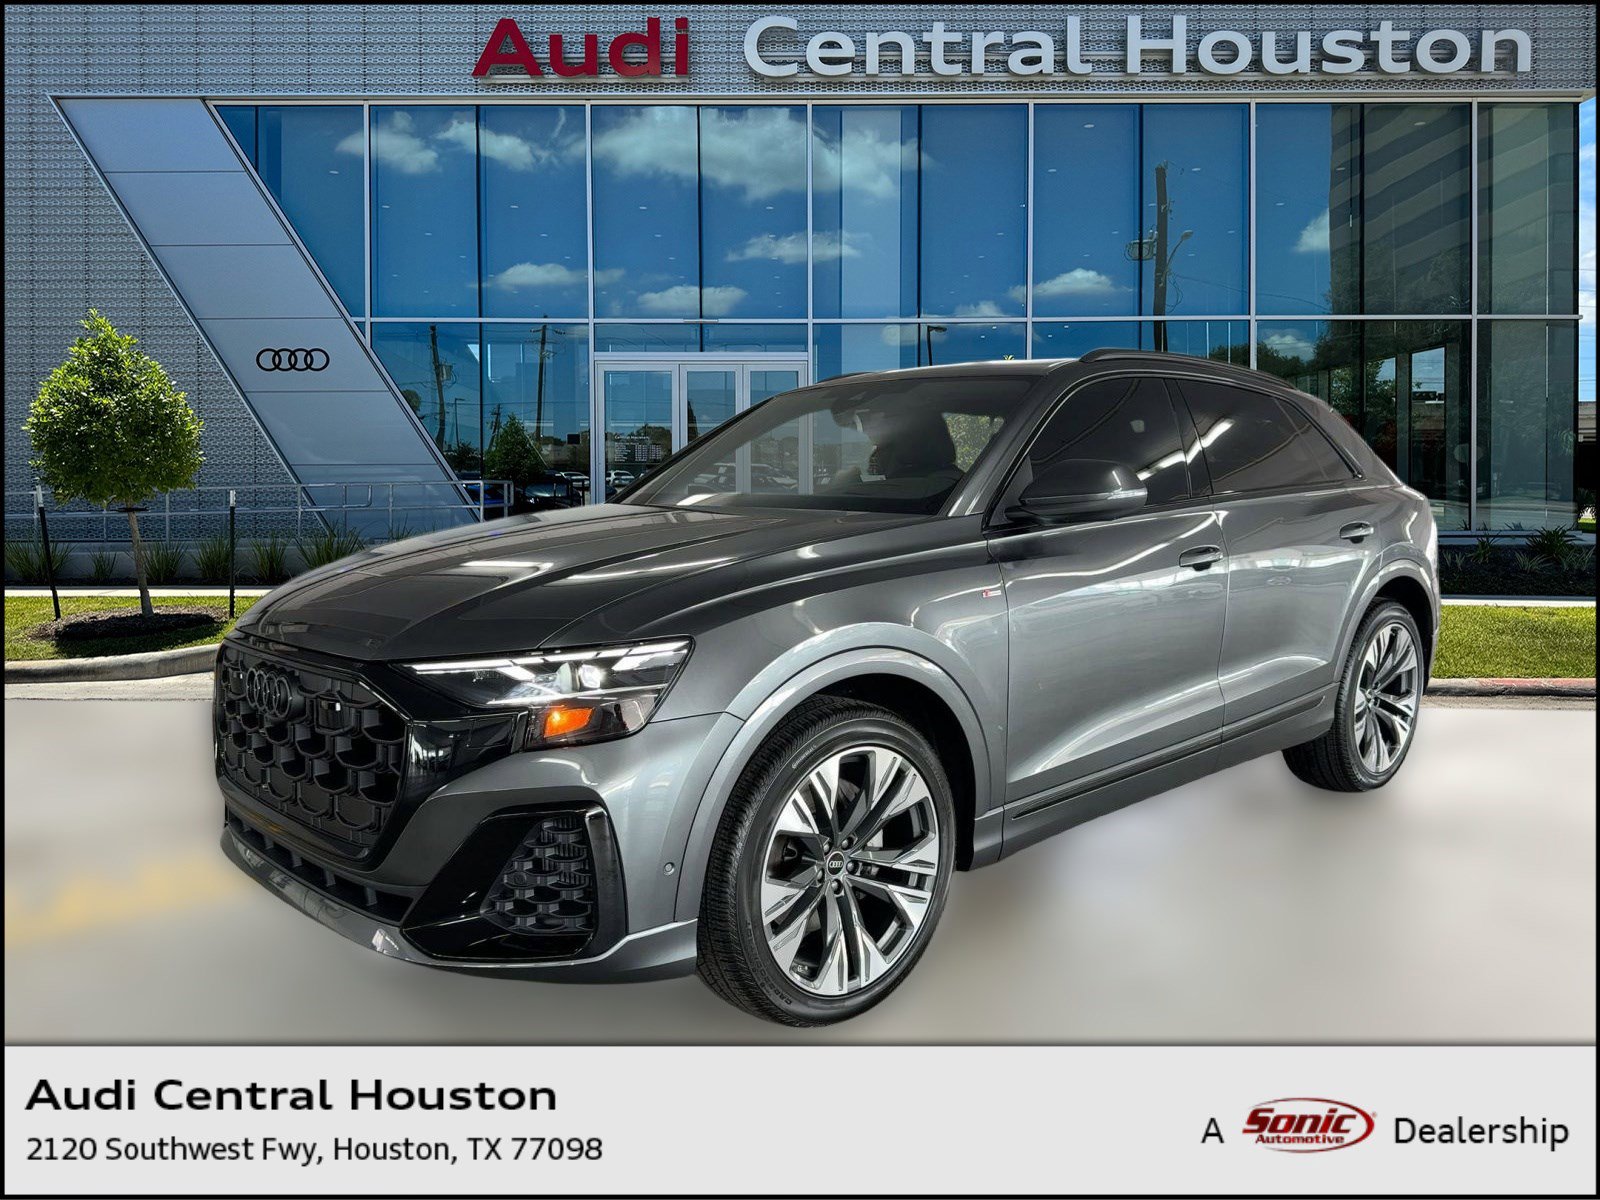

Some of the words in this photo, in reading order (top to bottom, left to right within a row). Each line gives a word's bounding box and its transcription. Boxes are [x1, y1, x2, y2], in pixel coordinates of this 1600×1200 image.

[471, 17, 688, 77] Audi
[744, 15, 1092, 75] Central
[1127, 15, 1531, 74] Houston
